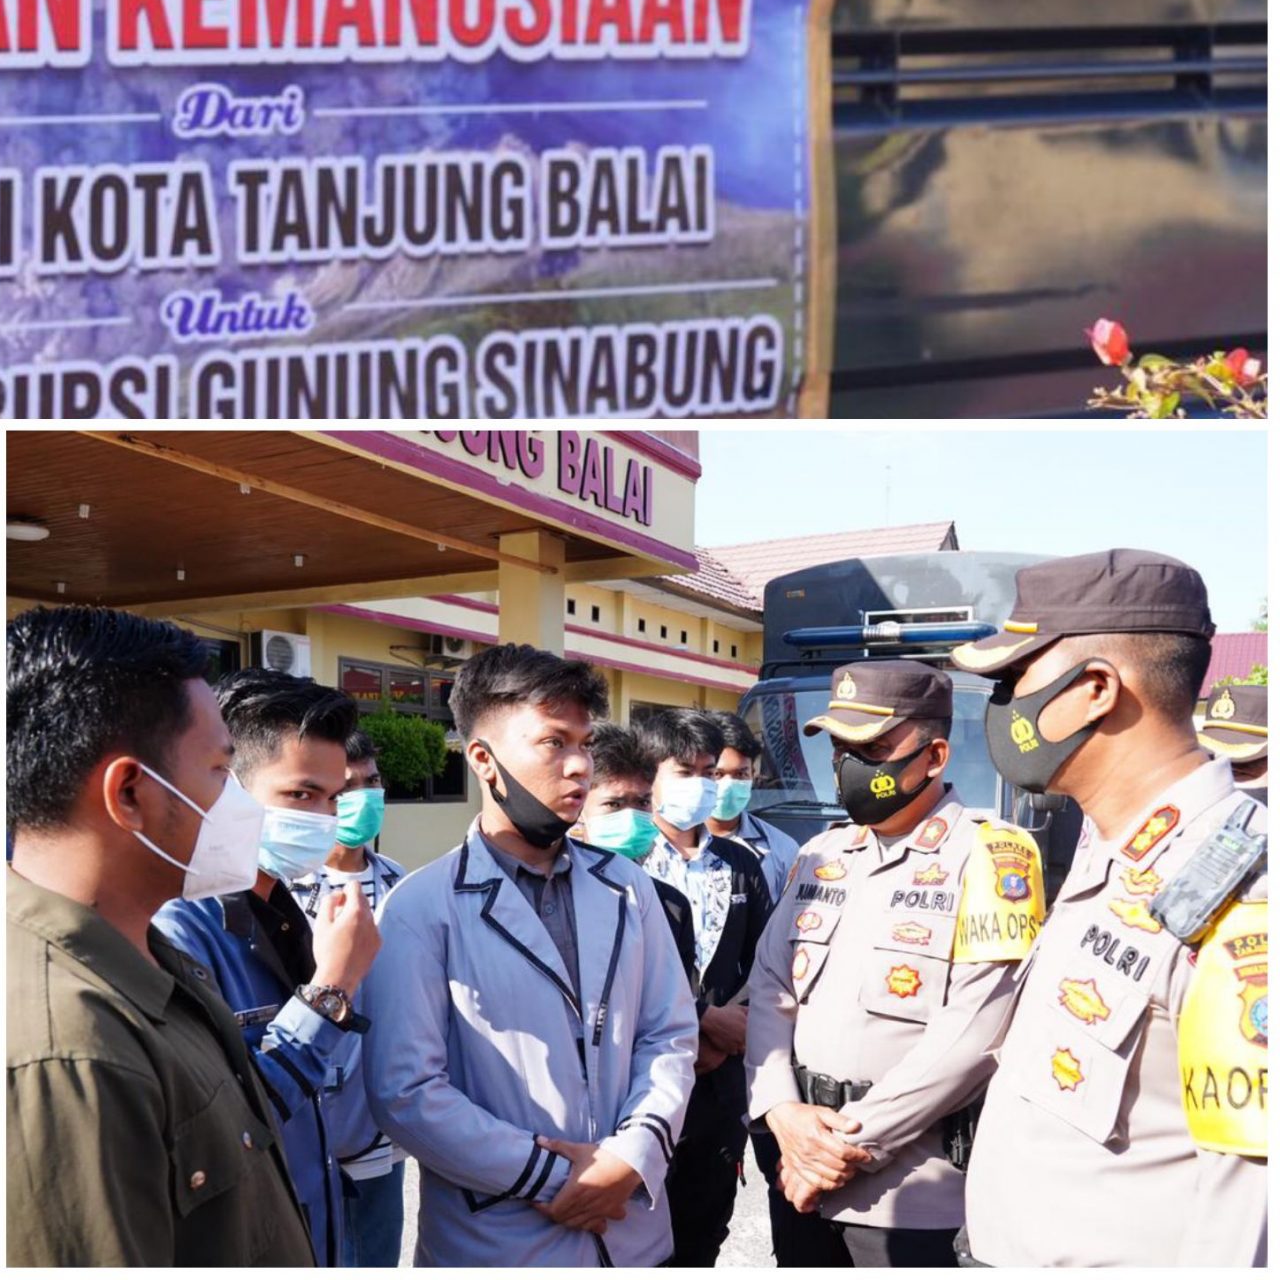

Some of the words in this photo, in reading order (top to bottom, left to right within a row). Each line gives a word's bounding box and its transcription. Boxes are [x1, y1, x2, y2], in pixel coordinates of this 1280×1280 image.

[177, 87, 303, 136] Dari
[41, 173, 213, 262] KOTA
[236, 160, 525, 254] TANJUNG
[546, 154, 708, 239] BALAI
[168, 293, 309, 336] Untuk
[196, 337, 460, 420] GUNUNG
[482, 324, 778, 420] SINABUNG
[557, 431, 655, 527] BALAI
[794, 883, 846, 907] JUMANTO
[890, 889, 955, 912] POLRI
[959, 911, 1003, 947] WAKA
[1080, 922, 1152, 983] POLRI
